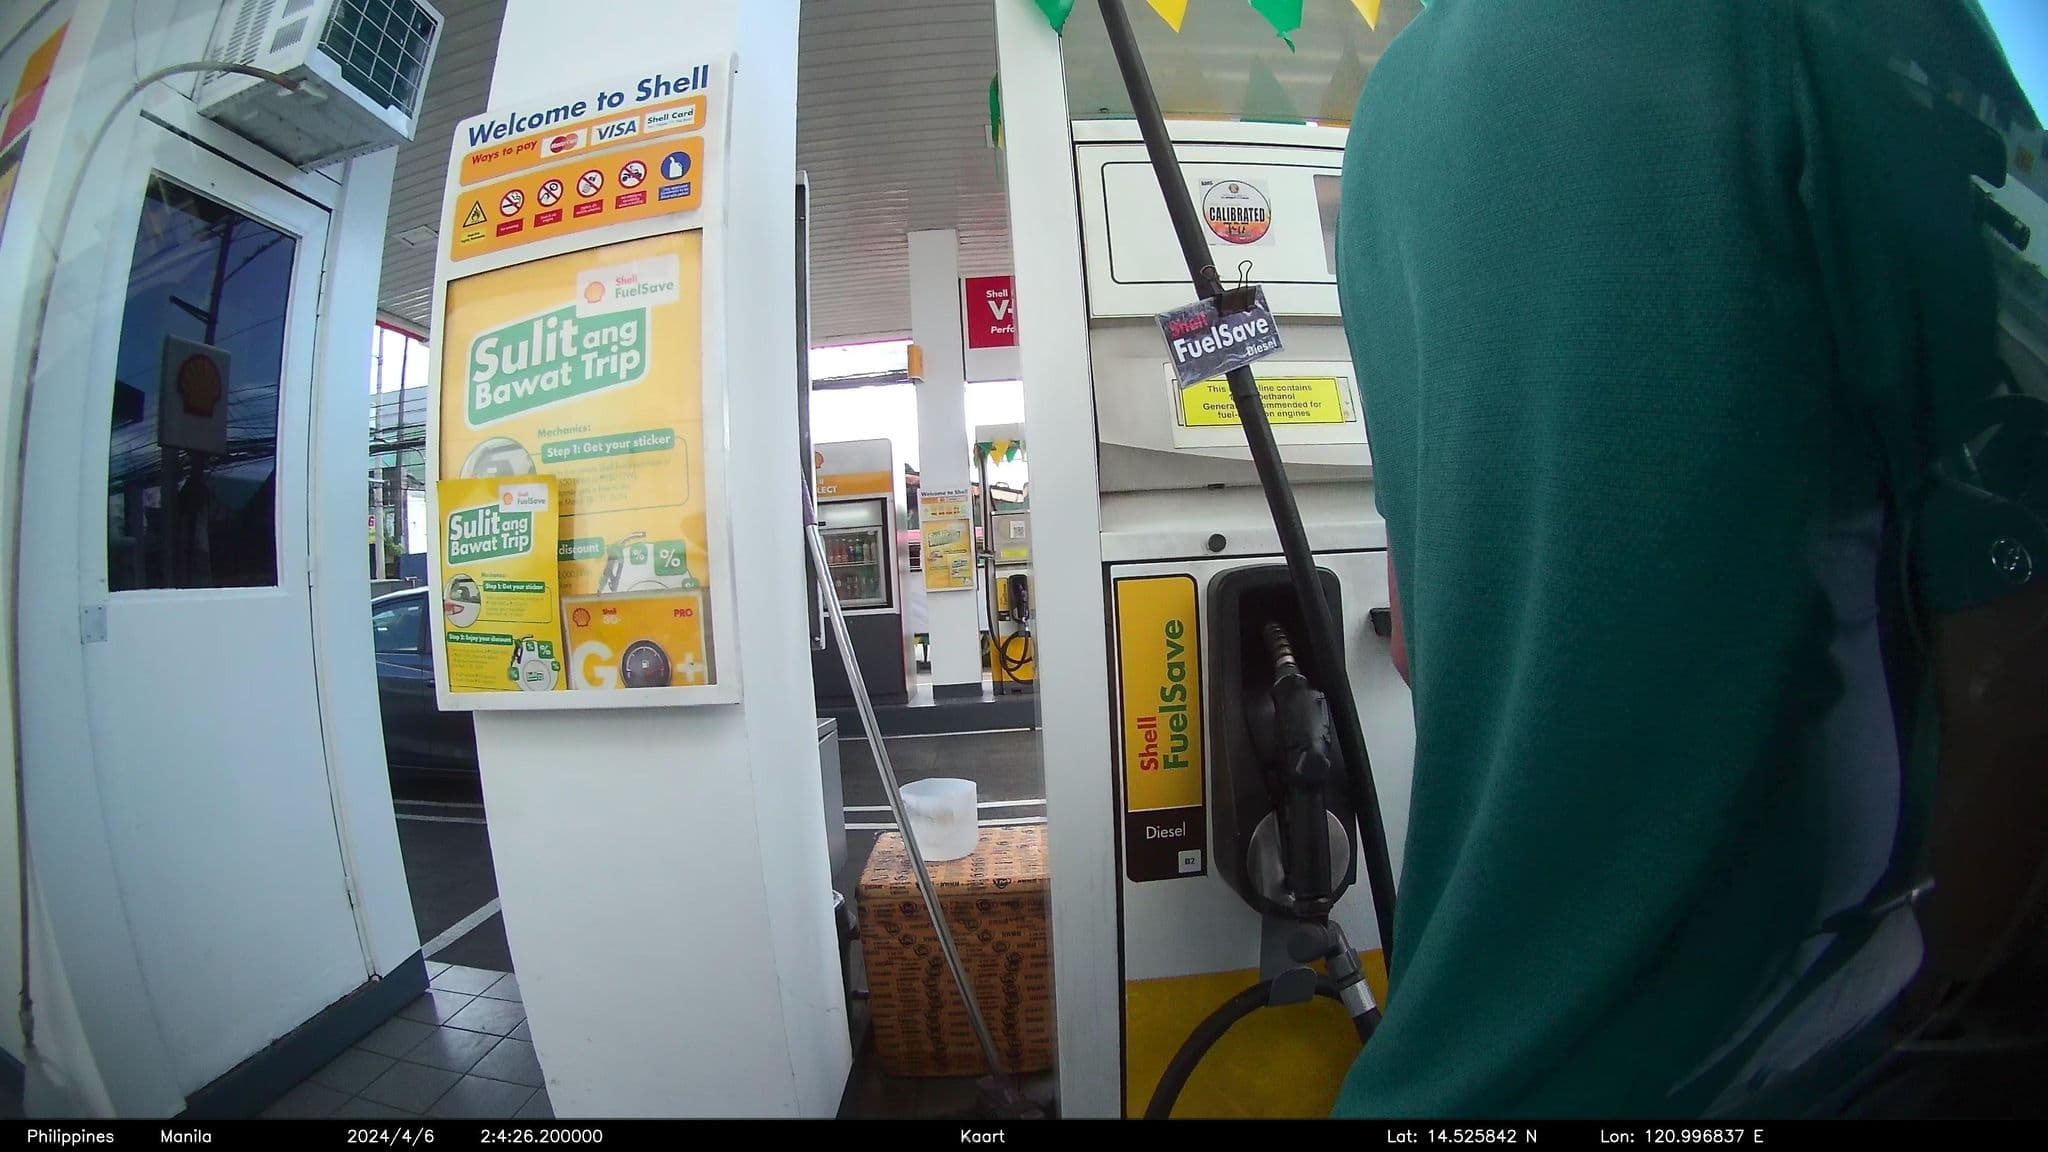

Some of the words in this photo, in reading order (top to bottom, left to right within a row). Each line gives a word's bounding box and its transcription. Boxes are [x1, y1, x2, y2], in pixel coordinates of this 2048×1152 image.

[469, 101, 587, 147] Welcome
[597, 91, 625, 111] to
[635, 64, 709, 102] Shell
[647, 114, 669, 124] Shell
[671, 108, 694, 119] Card
[596, 120, 637, 140] VISA
[471, 153, 499, 165] Ways
[502, 147, 513, 156] to
[516, 141, 539, 155] pay
[1209, 206, 1266, 222] CALIBRATED
[615, 275, 638, 287] Shell
[615, 281, 675, 299] FuelSave
[986, 289, 1009, 298] Shell
[472, 316, 579, 383] Sulit
[583, 320, 638, 348] ang
[1173, 318, 1269, 363] FuelSave
[1246, 337, 1278, 357] Diesel
[475, 362, 573, 410] Bawat
[581, 345, 641, 380] Trip
[1203, 402, 1235, 410] Genera
[537, 424, 592, 439] Mechanics:
[547, 447, 571, 458] Step
[573, 444, 581, 454] 1:
[583, 442, 604, 453] Get
[605, 439, 631, 453] your
[633, 434, 672, 447] sticker
[450, 508, 501, 541] Sulit
[502, 517, 528, 533] ang
[450, 536, 498, 556] Bawat
[501, 531, 529, 551] Trip
[558, 542, 600, 555] discount
[673, 608, 693, 617] PRO
[1159, 619, 1189, 770] FuelSave
[1137, 716, 1159, 771] Shell
[1146, 821, 1186, 839] Diesel
